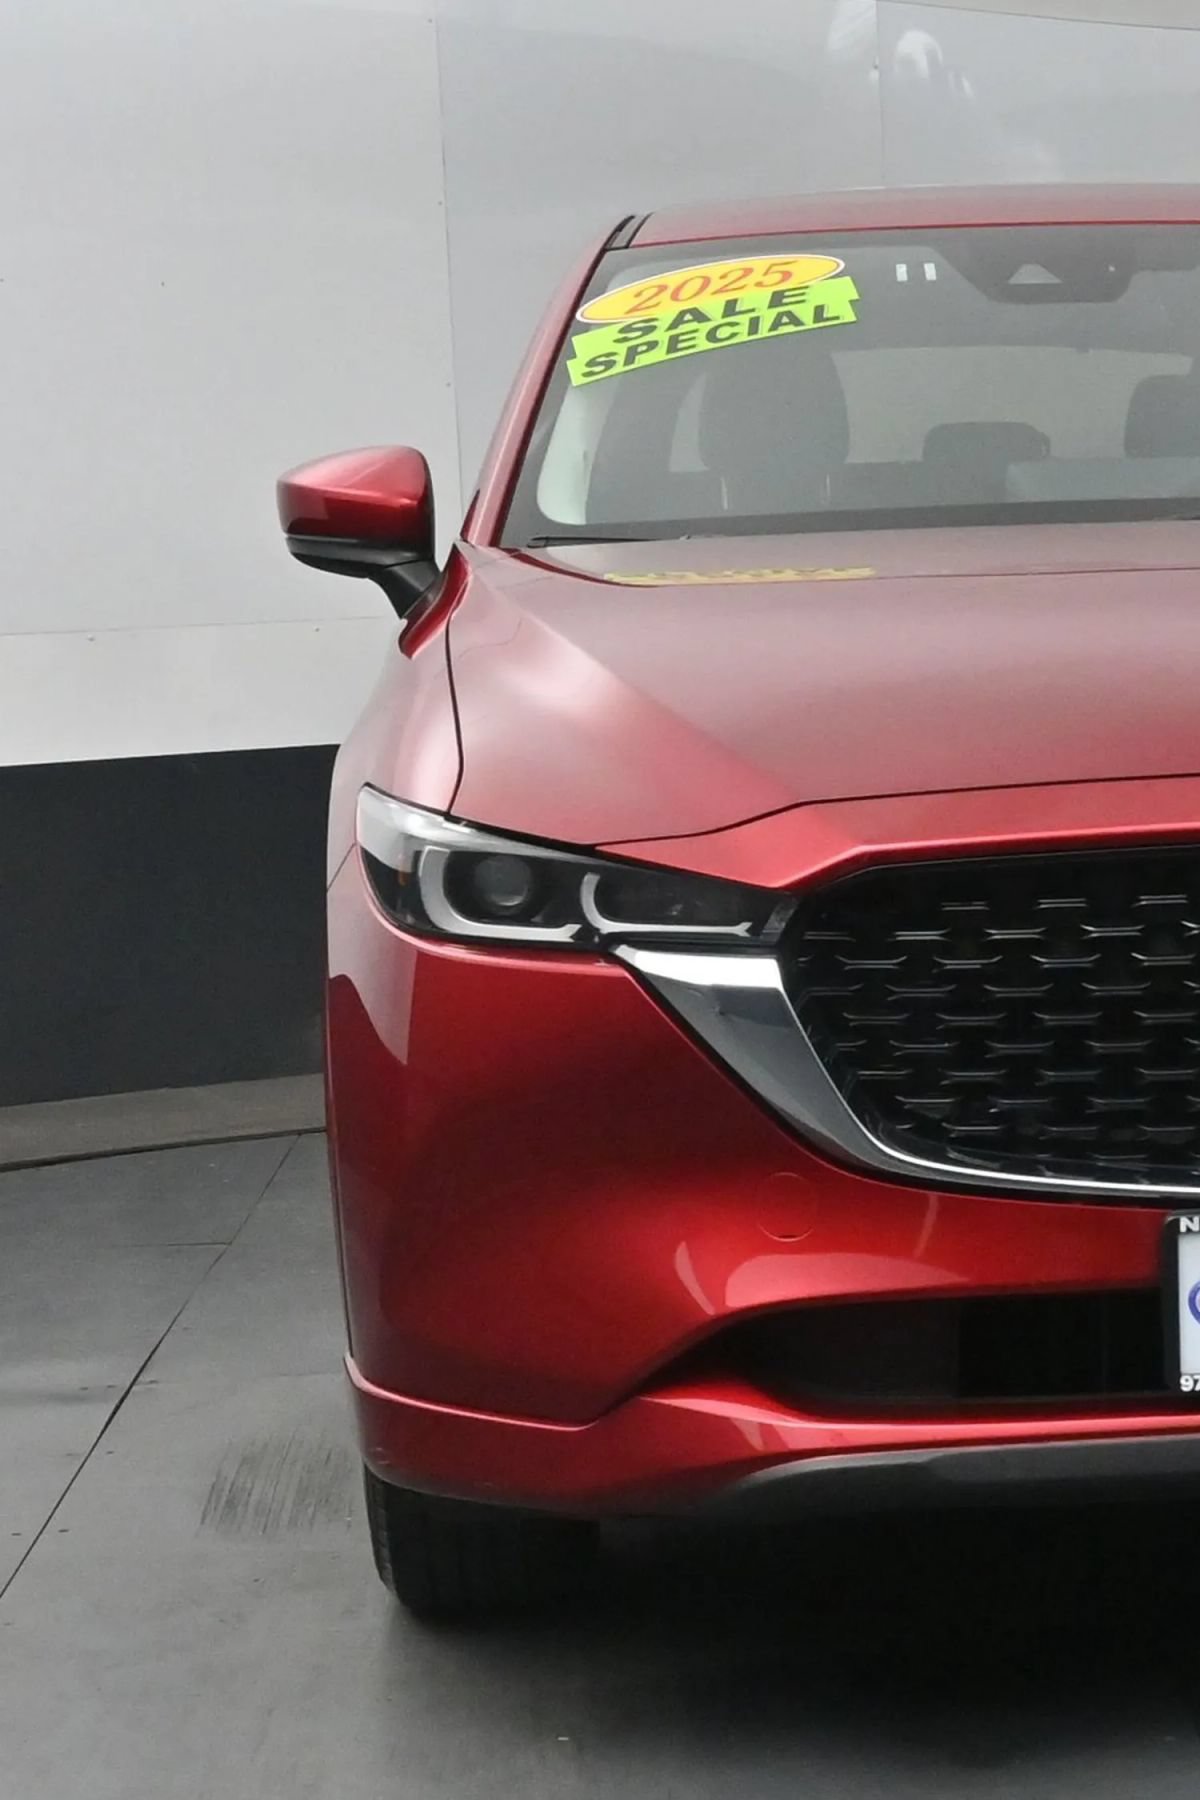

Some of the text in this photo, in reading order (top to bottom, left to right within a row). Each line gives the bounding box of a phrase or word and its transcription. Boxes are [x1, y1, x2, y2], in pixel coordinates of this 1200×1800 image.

[613, 285, 810, 344] SALE
[624, 260, 798, 315] 2025
[581, 304, 840, 378] SPECIAL
